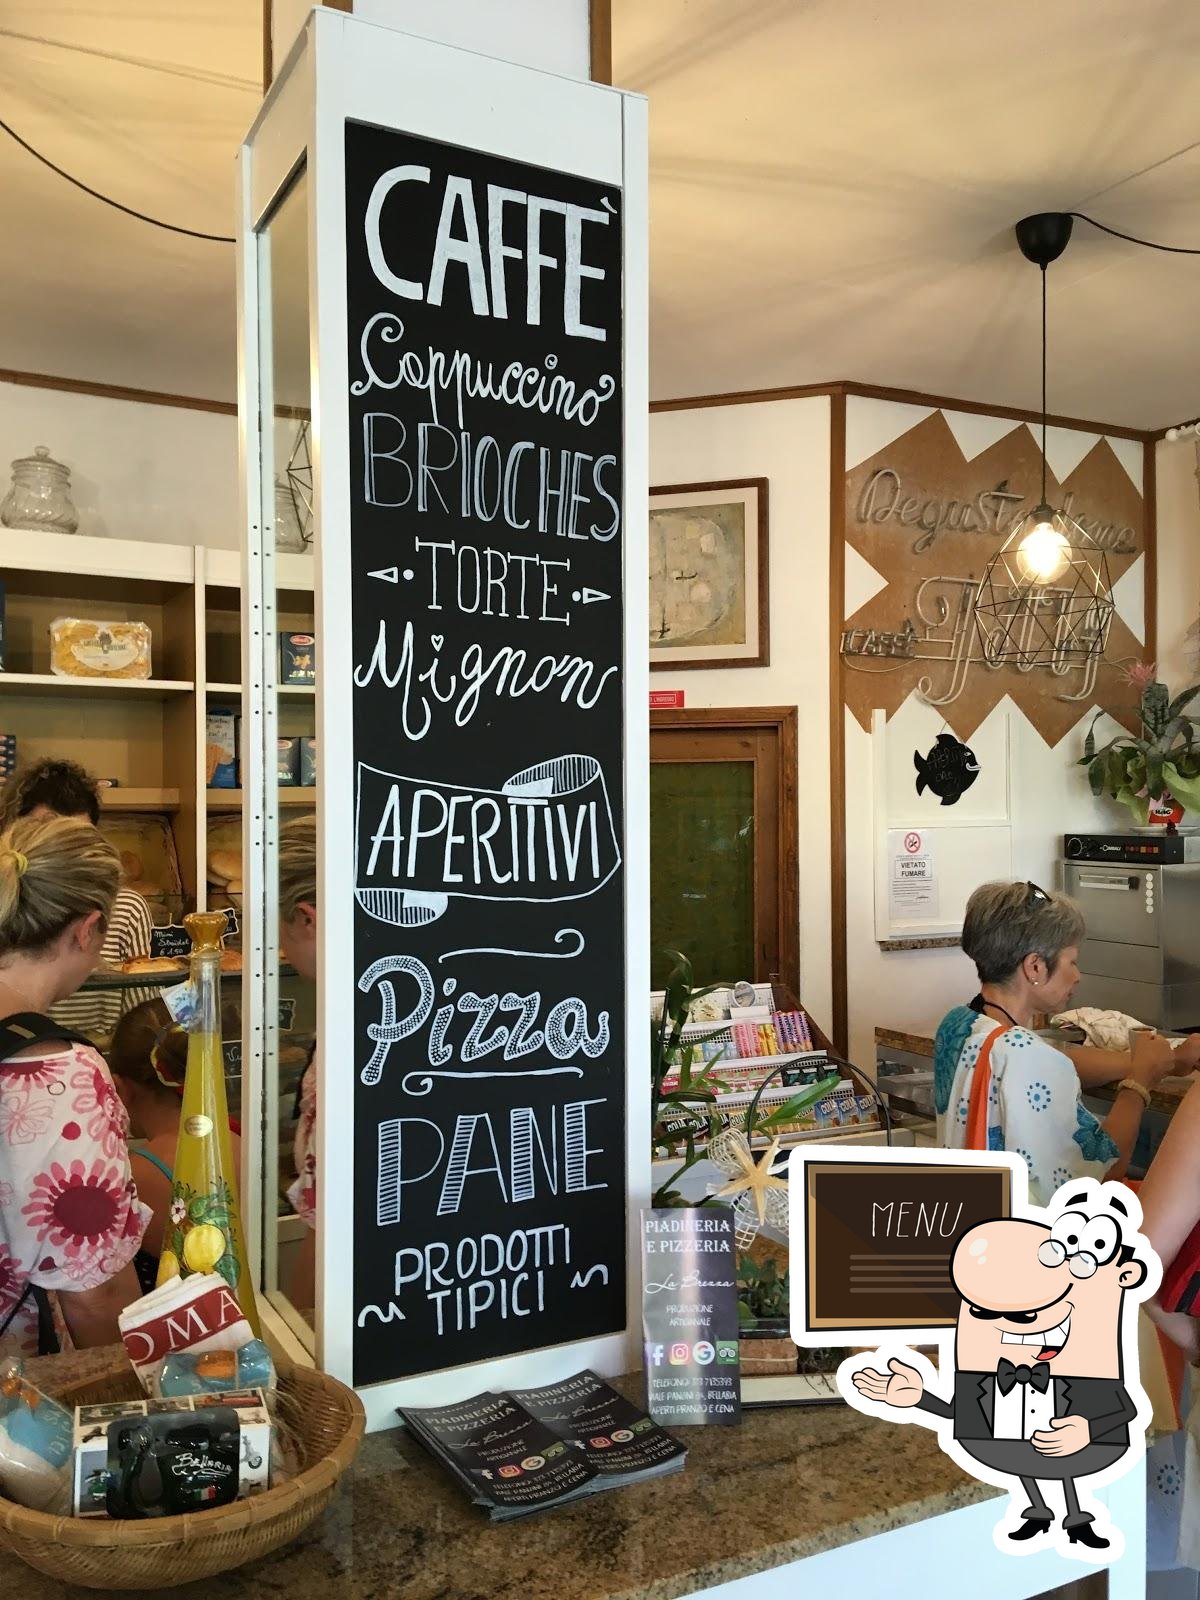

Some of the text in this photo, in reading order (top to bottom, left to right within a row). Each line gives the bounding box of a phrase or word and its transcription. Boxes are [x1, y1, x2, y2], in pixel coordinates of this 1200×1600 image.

[365, 165, 618, 342] CAFFÈ
[363, 412, 620, 542] BRIOCHES
[415, 536, 570, 627] TORTE
[354, 620, 619, 741] Mignon
[365, 784, 600, 884] APERITIVI
[900, 861, 926, 869] VIETATO
[901, 869, 926, 877] FUMARE
[358, 955, 611, 1086] Pizza
[377, 1098, 608, 1226] PANE
[394, 1224, 570, 1296] PRODOTTI
[647, 1239, 732, 1253] E PIZZERIA
[426, 1270, 545, 1336] TIPICI
[425, 1399, 509, 1425] PIADINERIA
[447, 1407, 517, 1433] PIZZERIA
[515, 1376, 595, 1400] PIADINERIA
